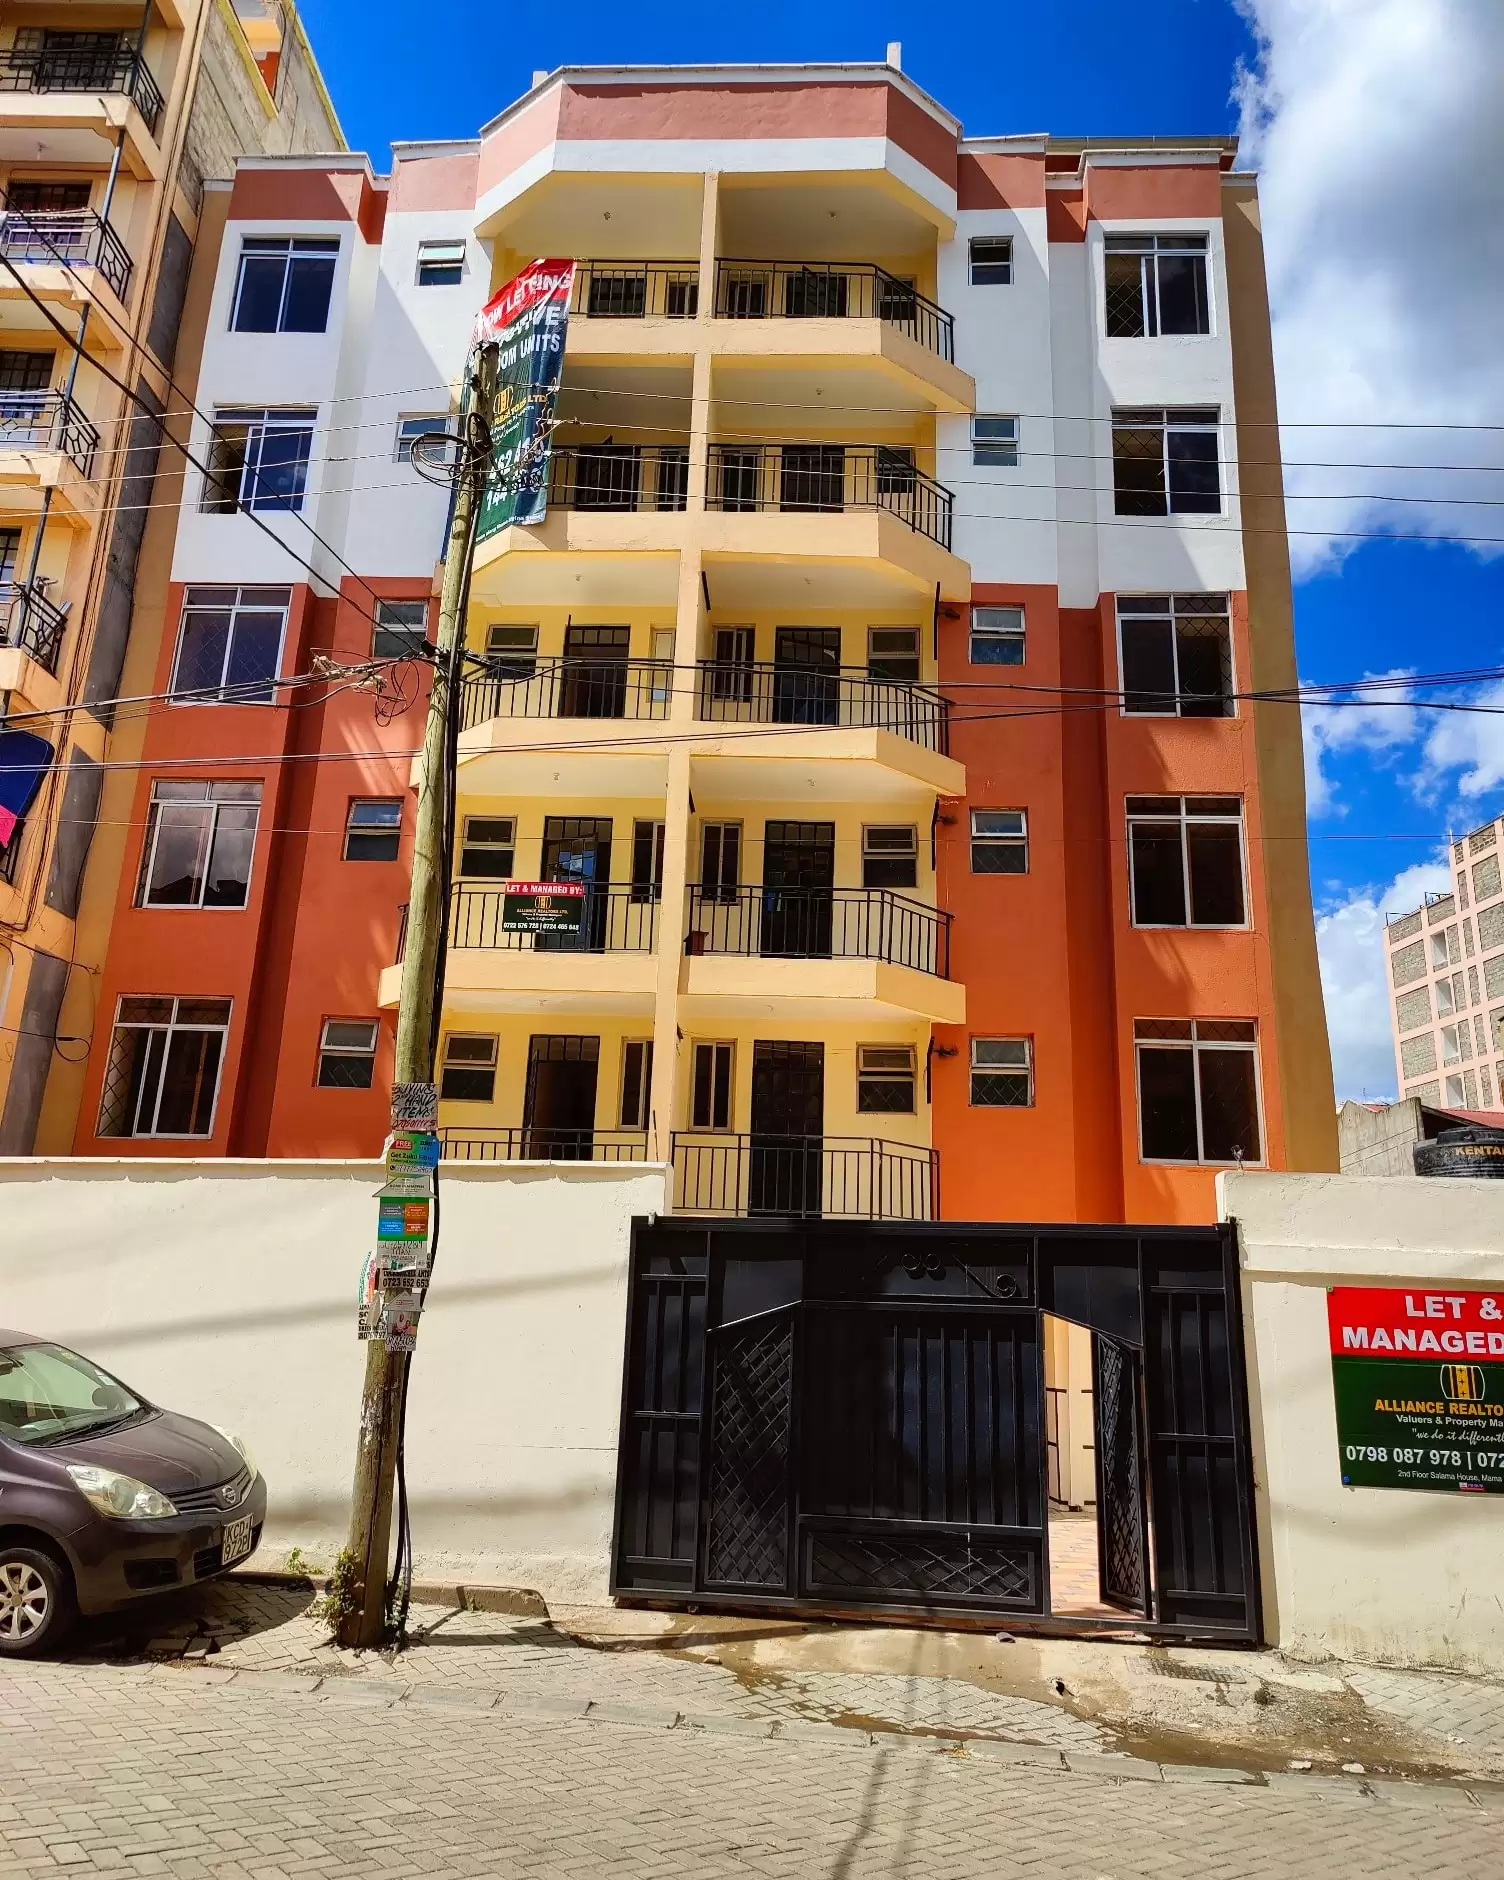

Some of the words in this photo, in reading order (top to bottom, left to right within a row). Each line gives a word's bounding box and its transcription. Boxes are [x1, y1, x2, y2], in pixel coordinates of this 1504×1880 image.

[521, 333, 561, 359] UNITS
[506, 884, 520, 892] LET
[522, 885, 528, 893] &
[530, 885, 568, 894] MANAGED
[395, 1140, 412, 1148] FREE
[383, 1278, 401, 1287] 0723
[402, 1278, 415, 1287] 652
[416, 1278, 430, 1288] 653
[1405, 1295, 1467, 1319] LET
[1479, 1297, 1503, 1321] &
[1342, 1326, 1504, 1355] MANAGED
[1375, 1399, 1445, 1414] ALLIANCE
[1396, 1414, 1433, 1424] Valuers
[1435, 1416, 1443, 1425] &
[1445, 1416, 1487, 1428] Property
[1430, 1429, 1444, 1440] do
[1446, 1431, 1457, 1441] it
[1346, 1446, 1388, 1462] 0798
[1393, 1448, 1425, 1464] 087
[1429, 1450, 1462, 1466] 978
[1397, 1470, 1411, 1478] 2nd
[1411, 1470, 1429, 1479] Floor
[1430, 1472, 1455, 1480] Salama
[226, 1521, 246, 1542] KCD
[225, 1535, 248, 1561] 972P
